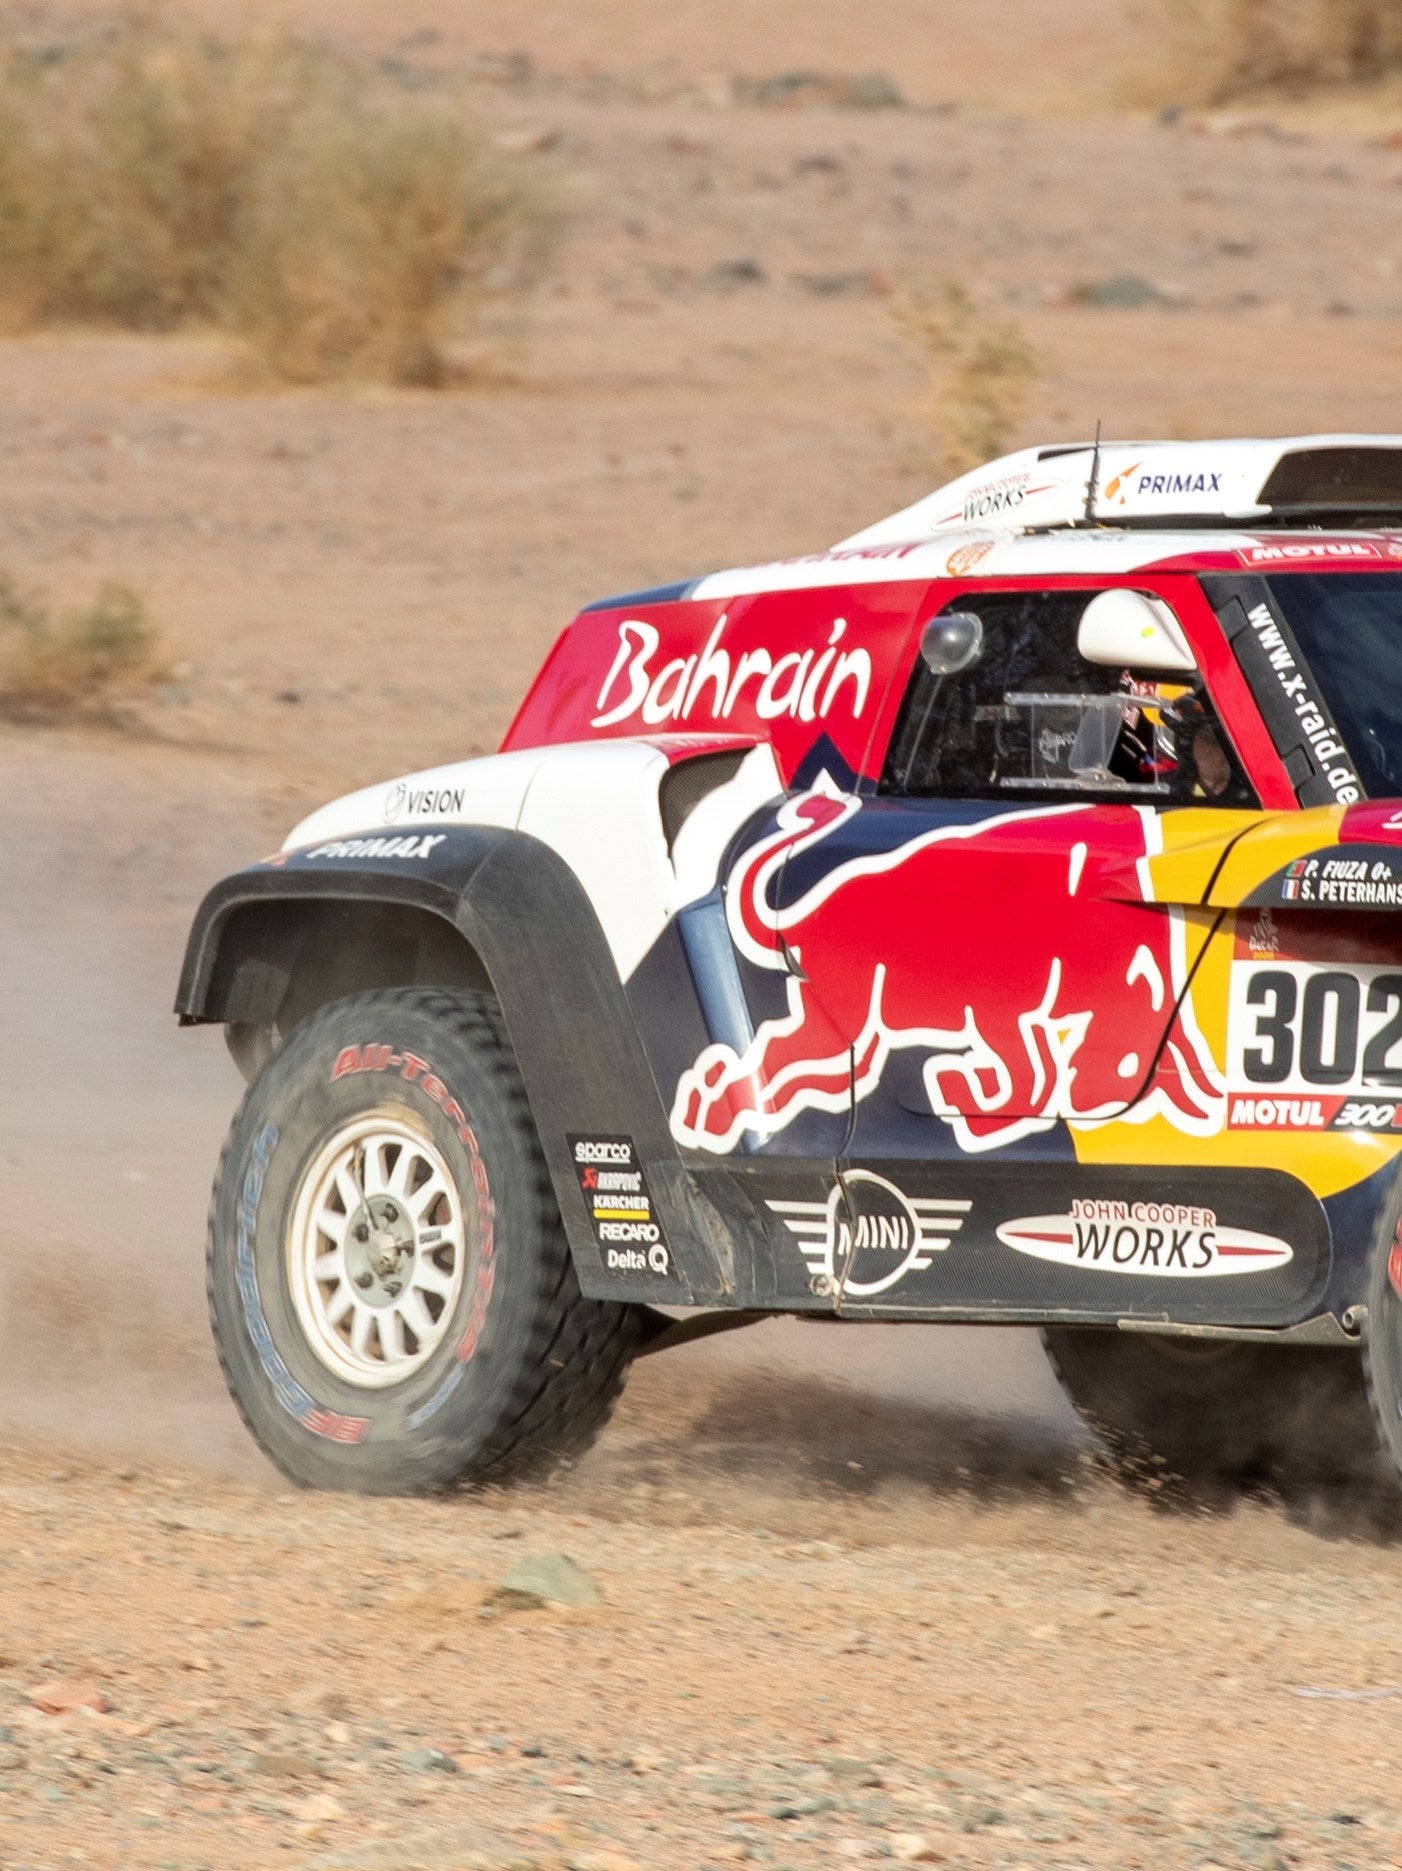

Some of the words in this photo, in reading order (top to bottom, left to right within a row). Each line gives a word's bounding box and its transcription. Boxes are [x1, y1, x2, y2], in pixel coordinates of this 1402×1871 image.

[1138, 473, 1223, 494] PRIMAX
[963, 485, 1027, 522] WORKS
[1252, 543, 1371, 561] MOTUL
[591, 614, 872, 728] Bahrain
[1247, 602, 1360, 806] www.x-raid.de
[408, 789, 466, 814] VISION
[306, 834, 447, 859] PRIMAX
[1304, 859, 1319, 878] P.
[1322, 860, 1368, 880] FIUZA
[1301, 880, 1315, 900] S.
[1231, 1100, 1324, 1126] MOTUL
[575, 1142, 631, 1164] sparco
[1072, 1202, 1126, 1221] JOHN
[1135, 1205, 1214, 1228] COOPER
[600, 1222, 660, 1241] RECARO
[838, 1215, 908, 1255] MINI
[1075, 1222, 1216, 1268] WORKS
[607, 1249, 646, 1269] Delta
